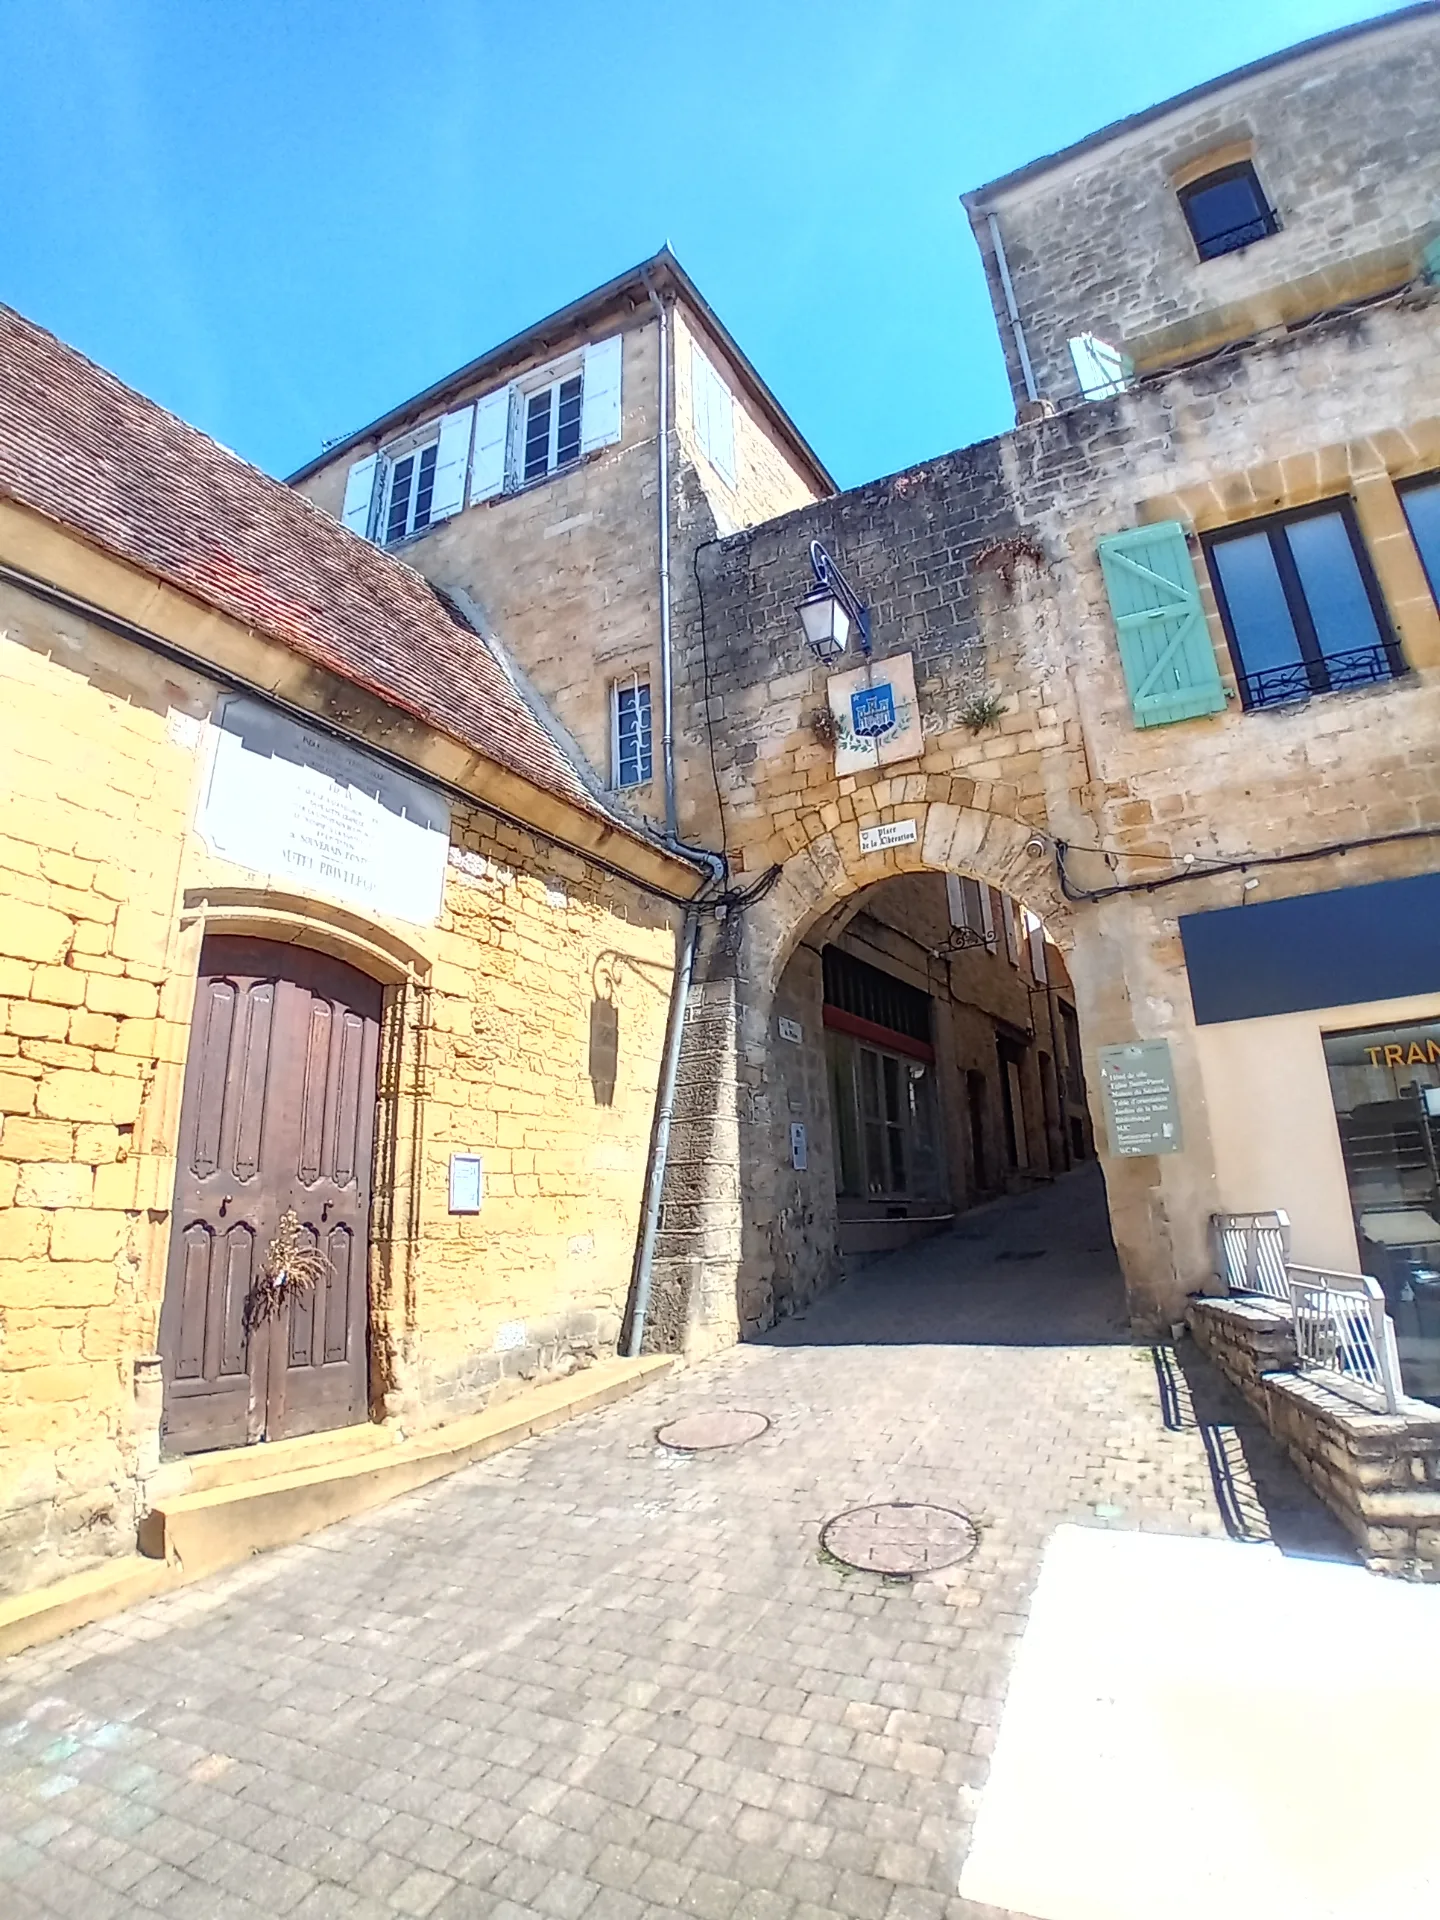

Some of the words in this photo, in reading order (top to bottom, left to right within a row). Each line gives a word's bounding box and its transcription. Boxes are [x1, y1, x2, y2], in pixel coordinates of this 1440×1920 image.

[877, 826, 896, 838] Place
[862, 842, 869, 850] de
[871, 839, 877, 848] la
